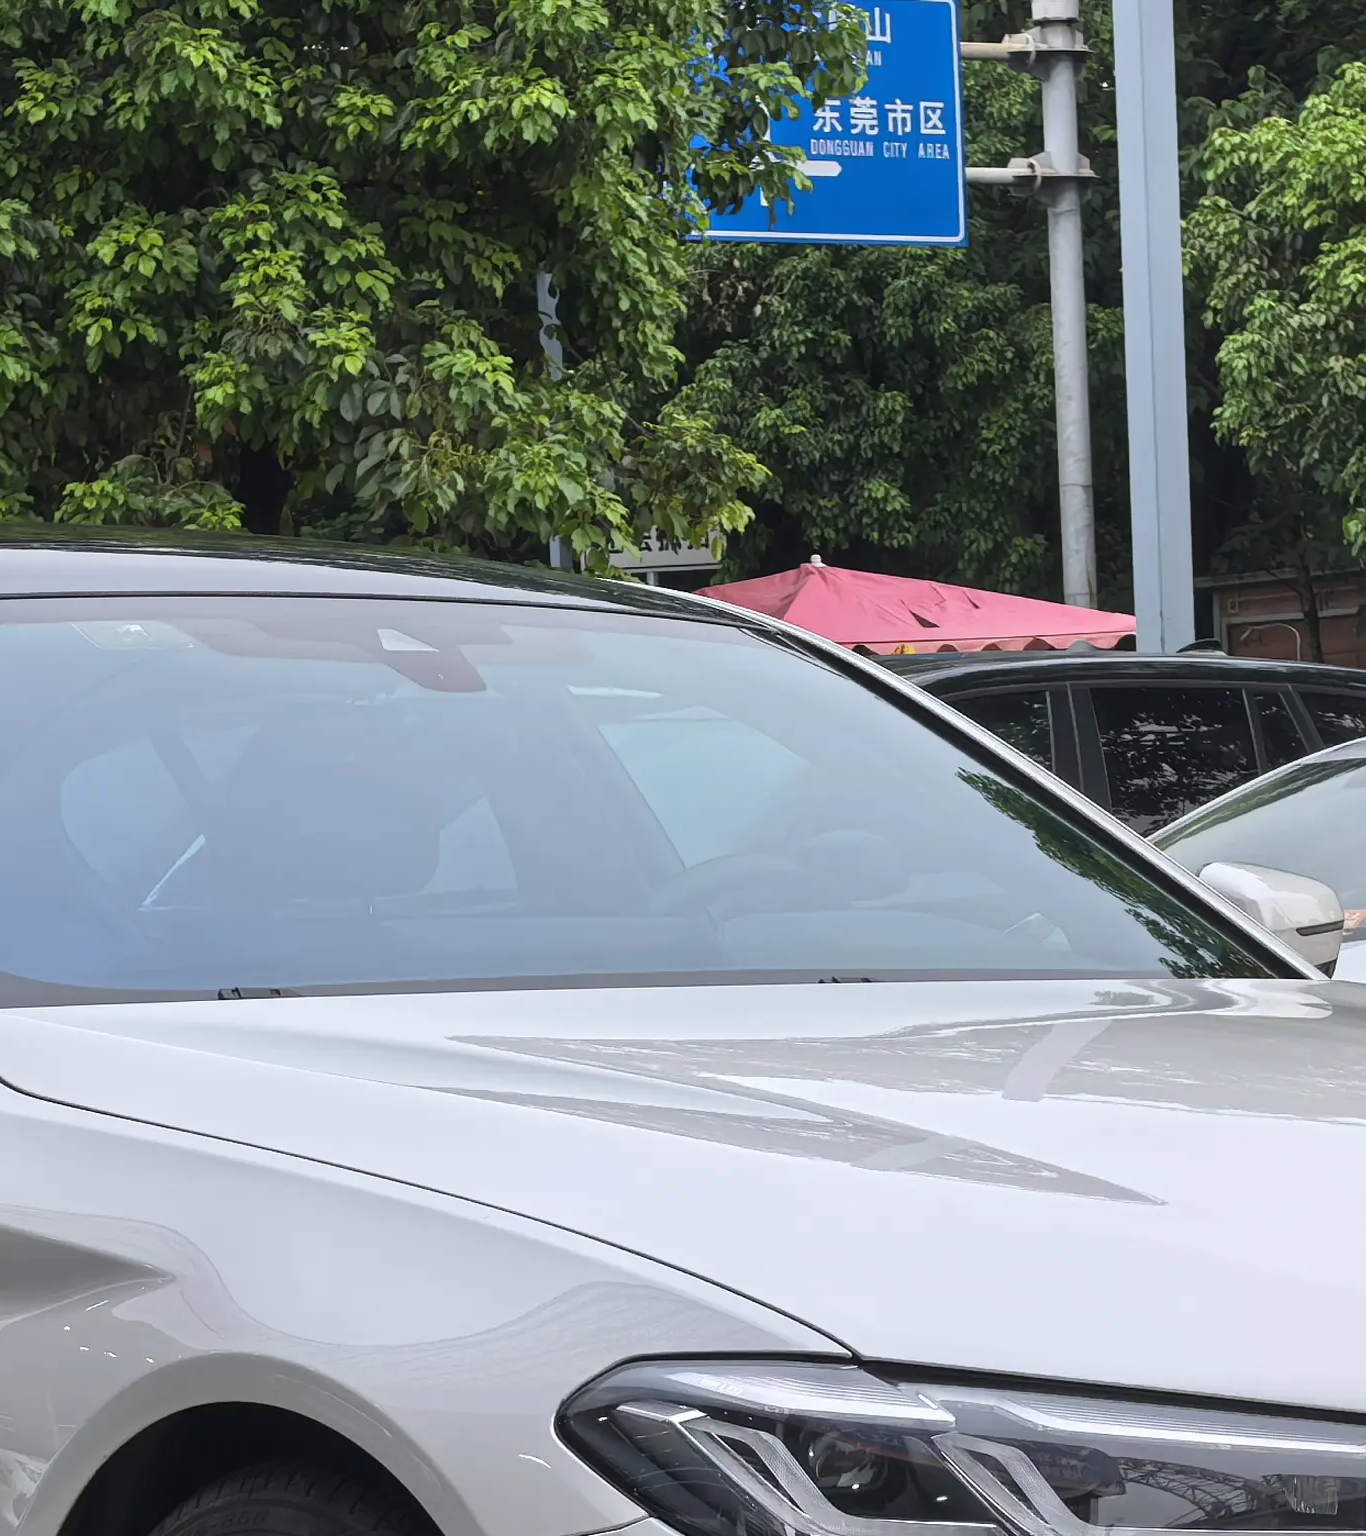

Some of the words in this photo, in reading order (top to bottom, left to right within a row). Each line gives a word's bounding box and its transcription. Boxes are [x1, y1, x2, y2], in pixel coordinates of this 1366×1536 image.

[811, 97, 947, 136] 东莞市区
[810, 138, 874, 157] DONGGUAN
[882, 141, 908, 158] CITY
[917, 142, 951, 160] AREA
